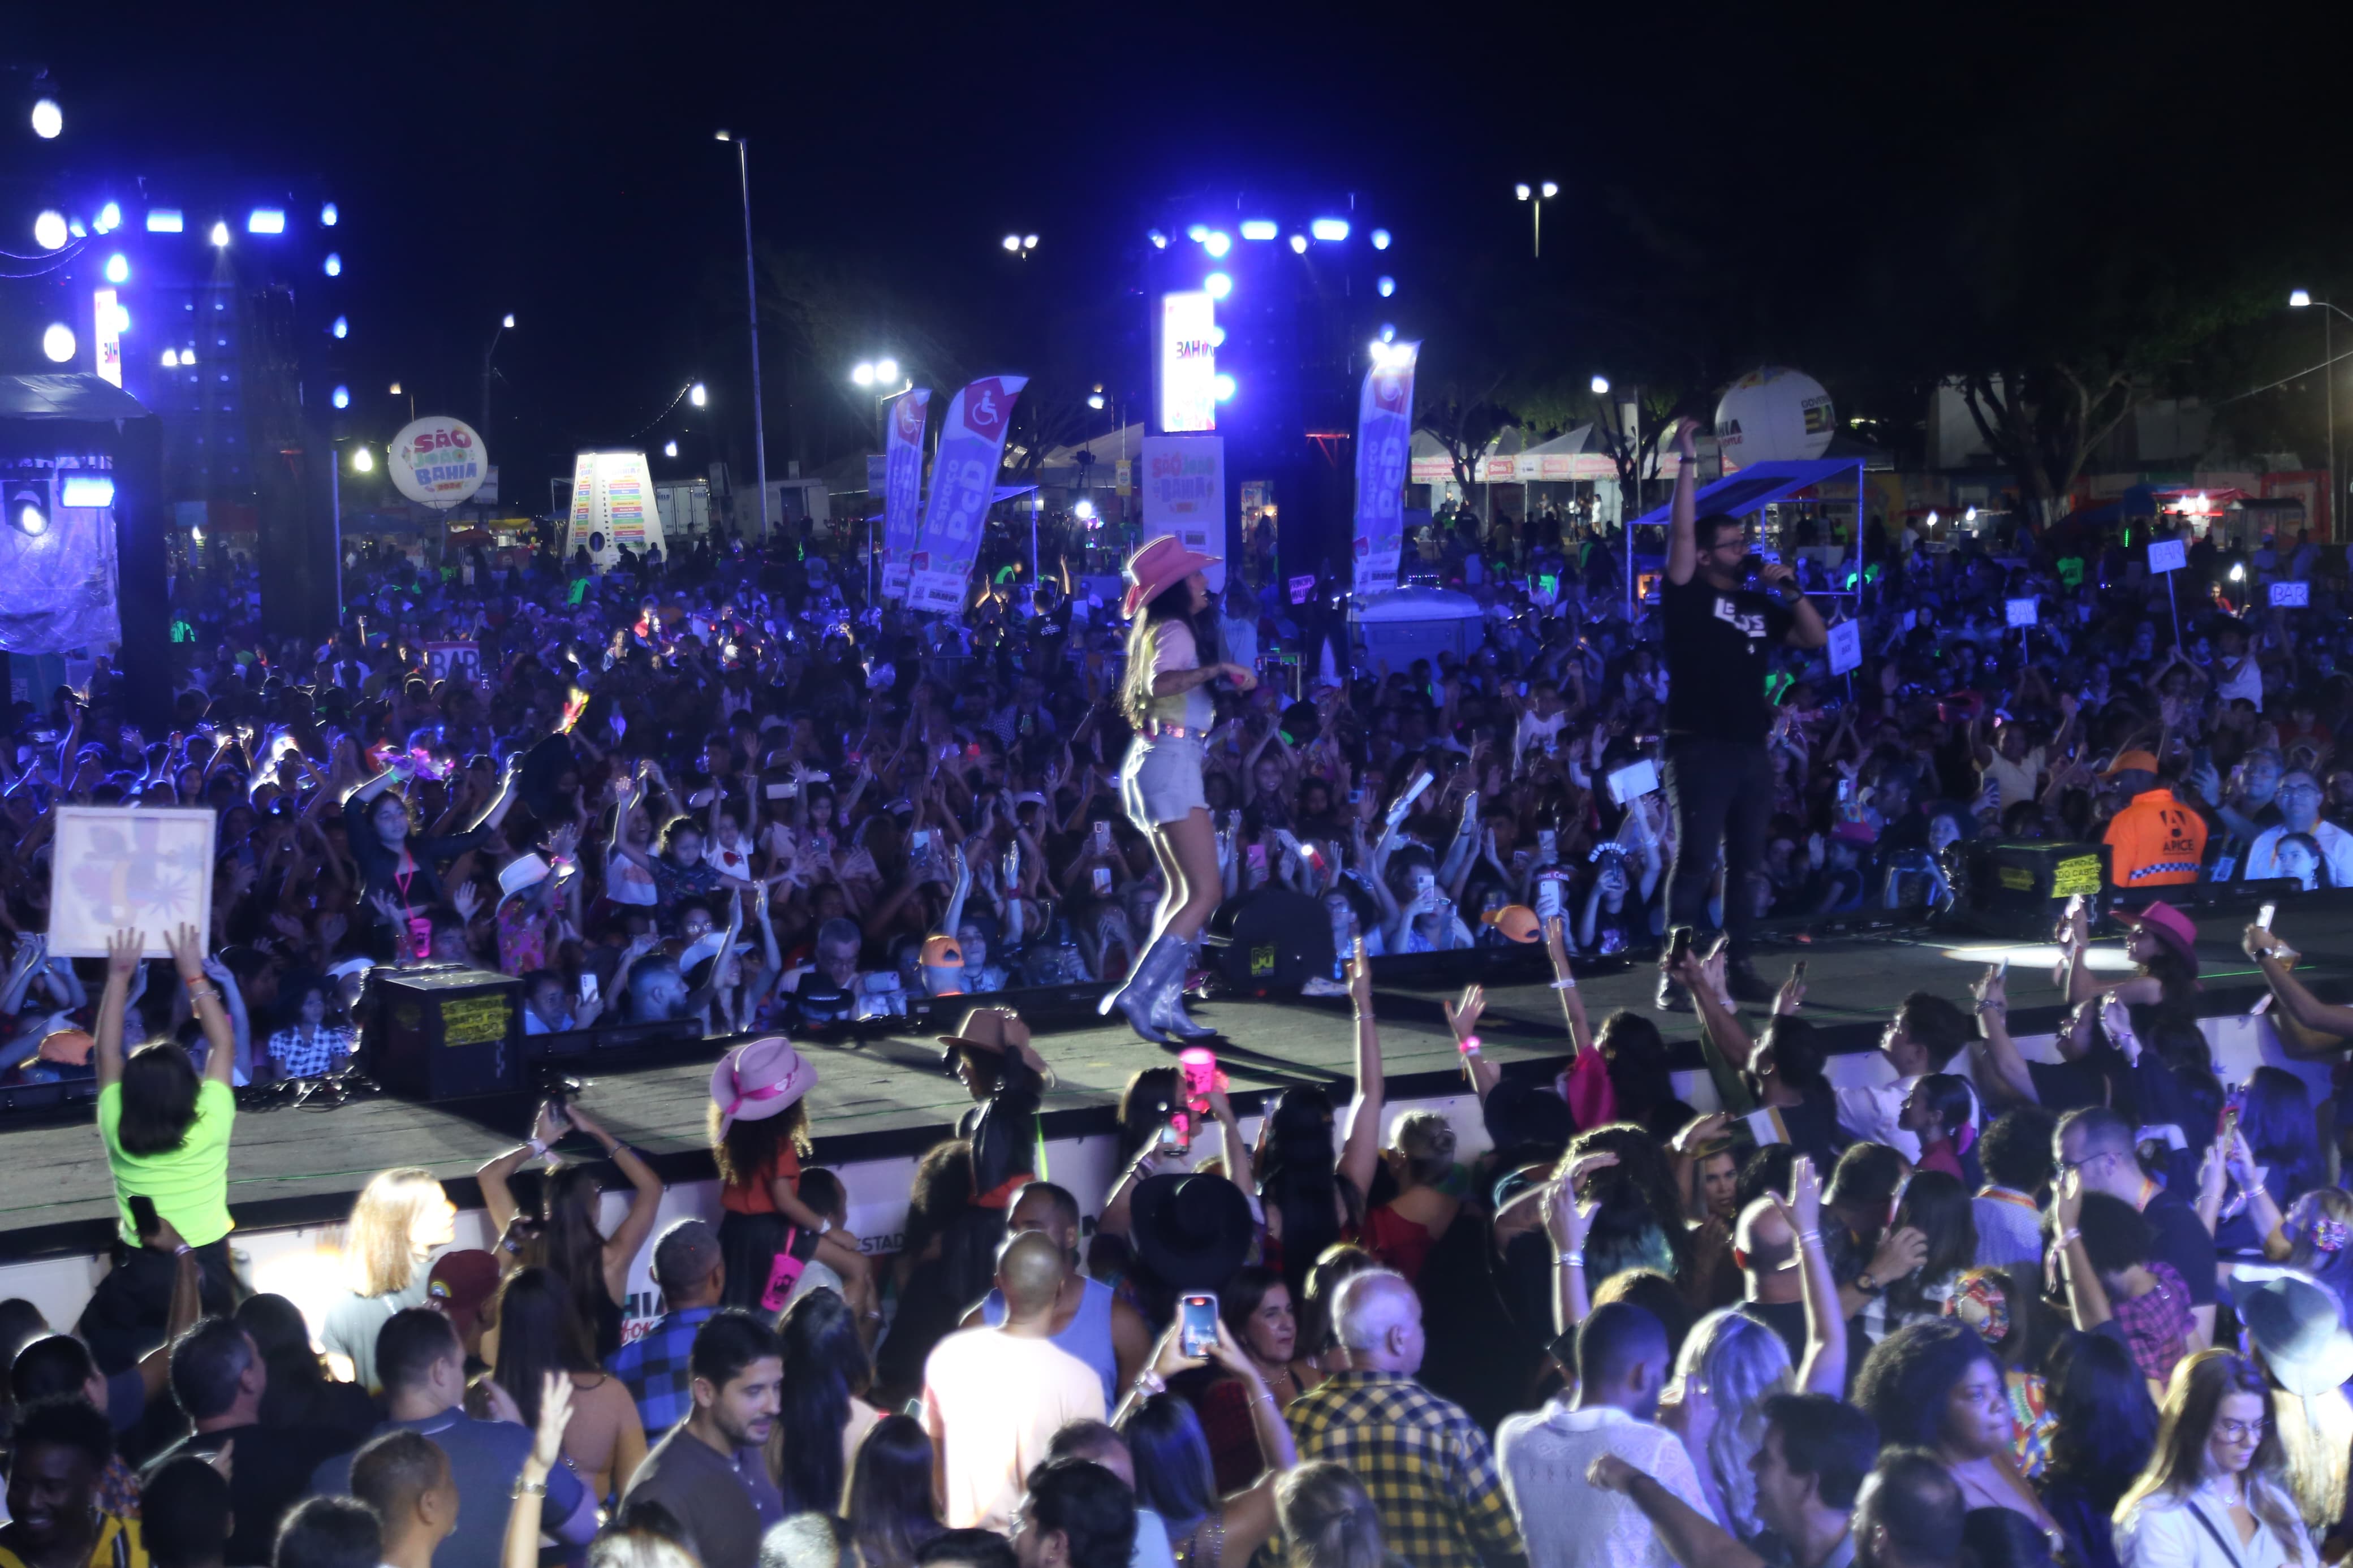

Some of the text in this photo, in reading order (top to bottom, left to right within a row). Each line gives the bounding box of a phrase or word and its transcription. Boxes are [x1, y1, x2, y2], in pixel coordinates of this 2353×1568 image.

[414, 429, 472, 453] SÃO
[413, 448, 467, 468] JOÃO
[415, 463, 477, 485] BAHIA
[1363, 441, 1379, 519] Espaço
[929, 460, 960, 535] Espaço
[2153, 542, 2184, 564] BAR
[2274, 585, 2308, 603] BAR
[429, 651, 479, 680] BAR
